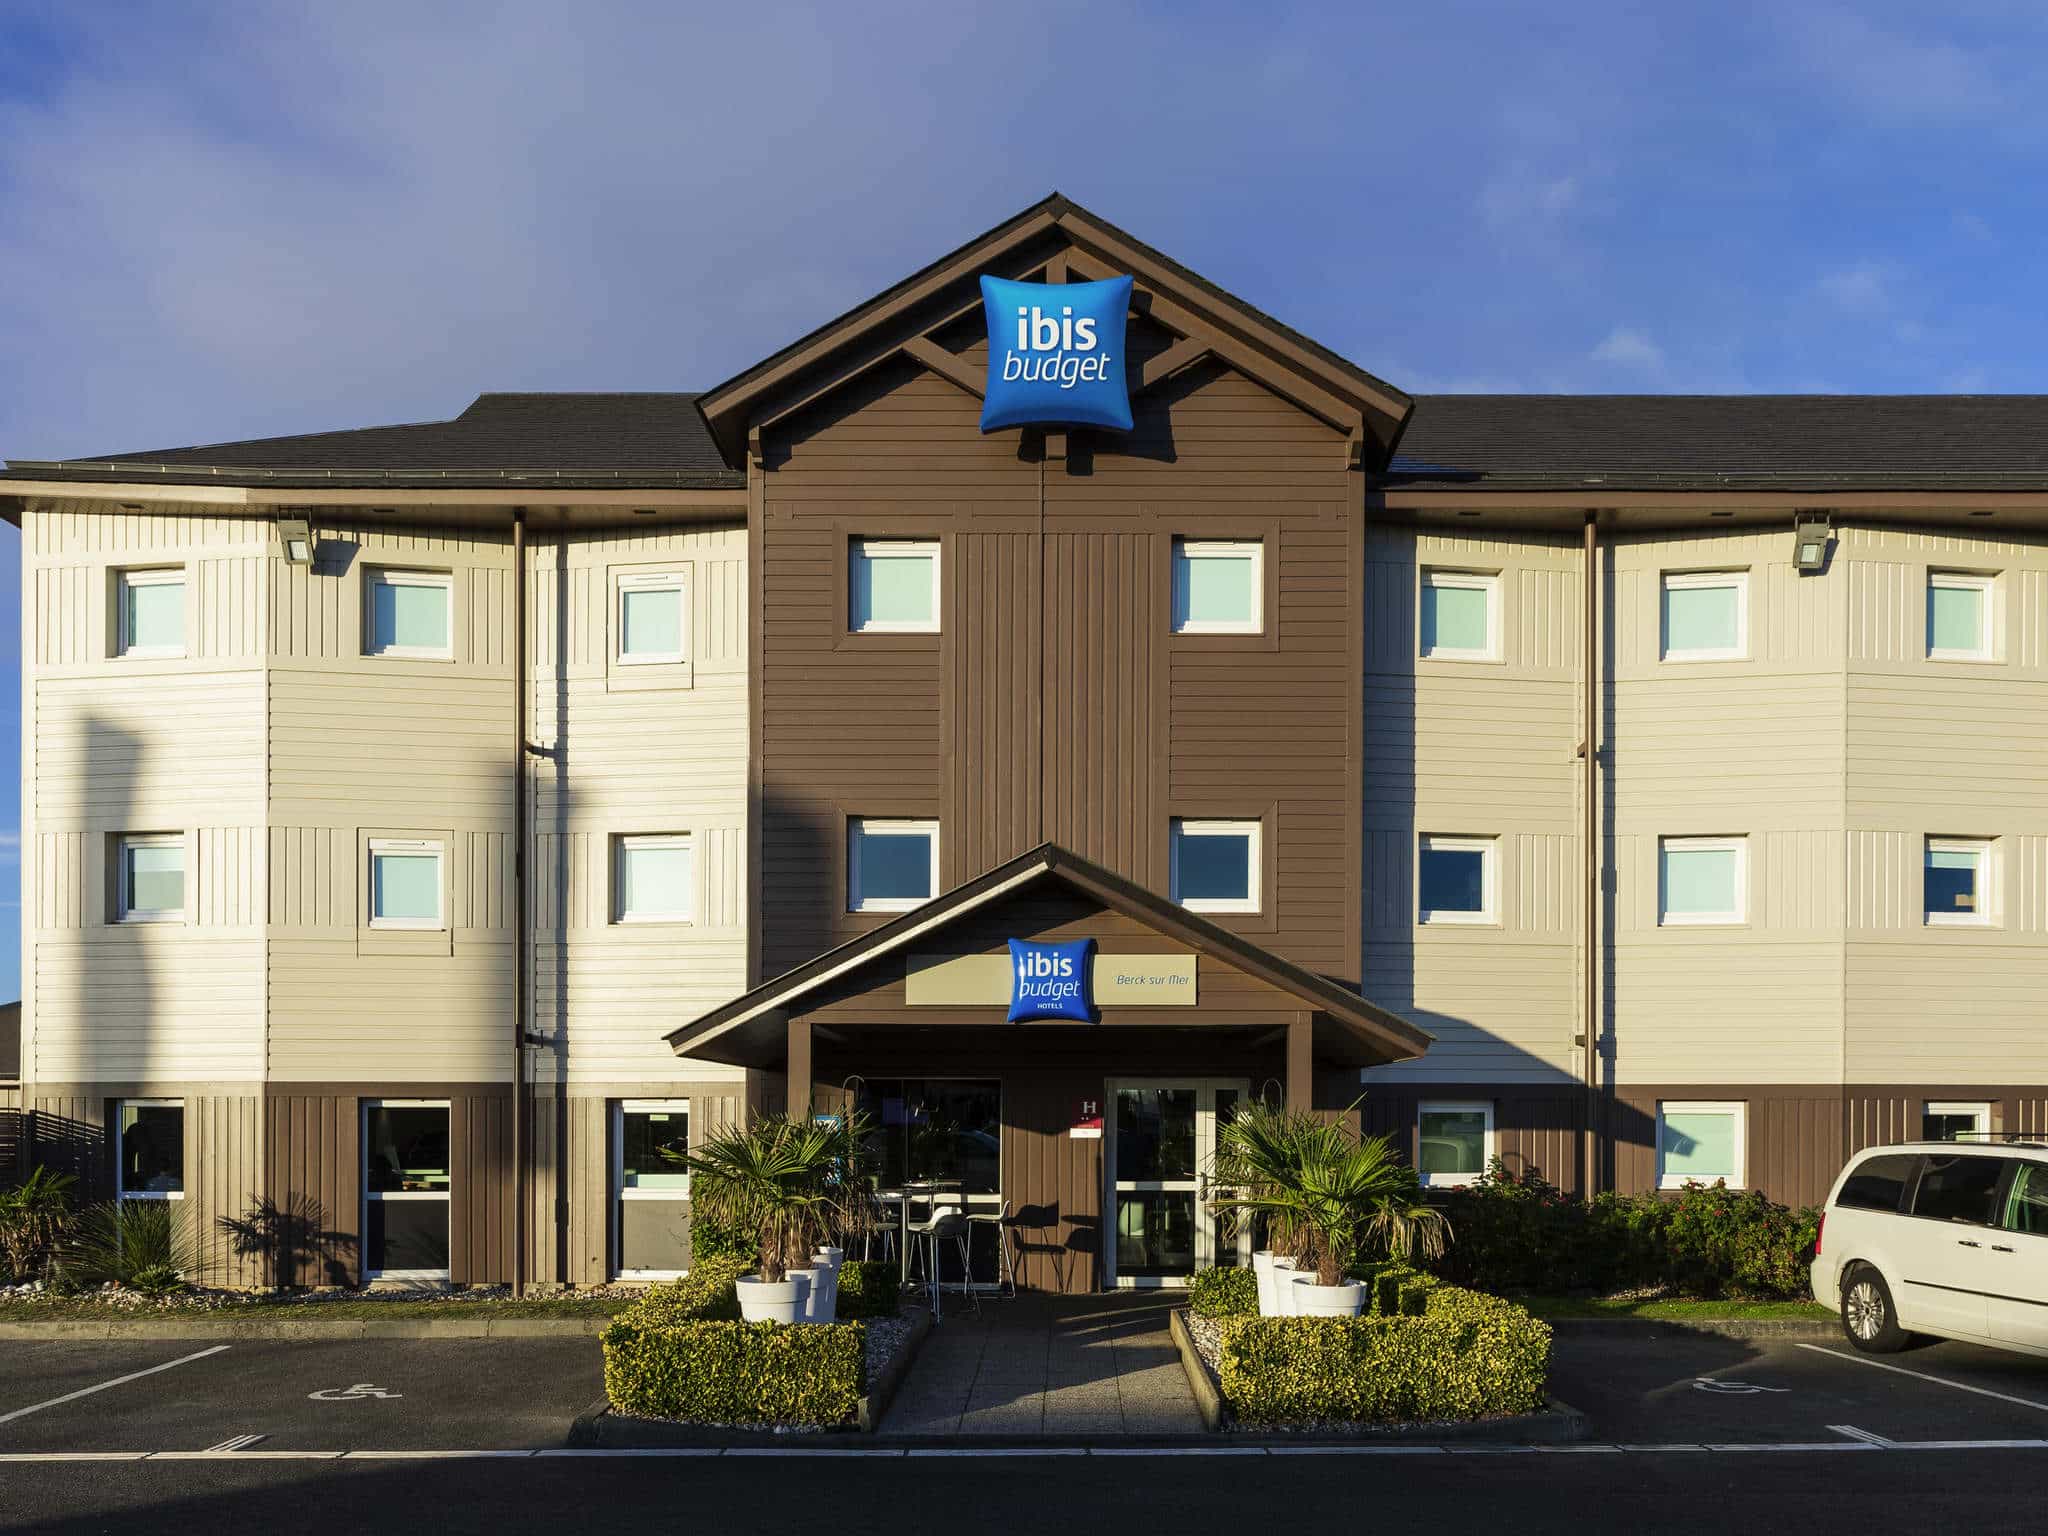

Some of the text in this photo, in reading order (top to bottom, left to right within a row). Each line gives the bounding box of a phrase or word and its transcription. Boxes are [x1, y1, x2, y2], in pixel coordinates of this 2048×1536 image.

[1018, 306, 1097, 350] ibis
[1003, 349, 1110, 388] budget
[1027, 952, 1073, 977] ibis
[1020, 978, 1080, 1001] budget
[1116, 975, 1189, 985] Berck sur Mer
[1083, 1101, 1097, 1113] H
